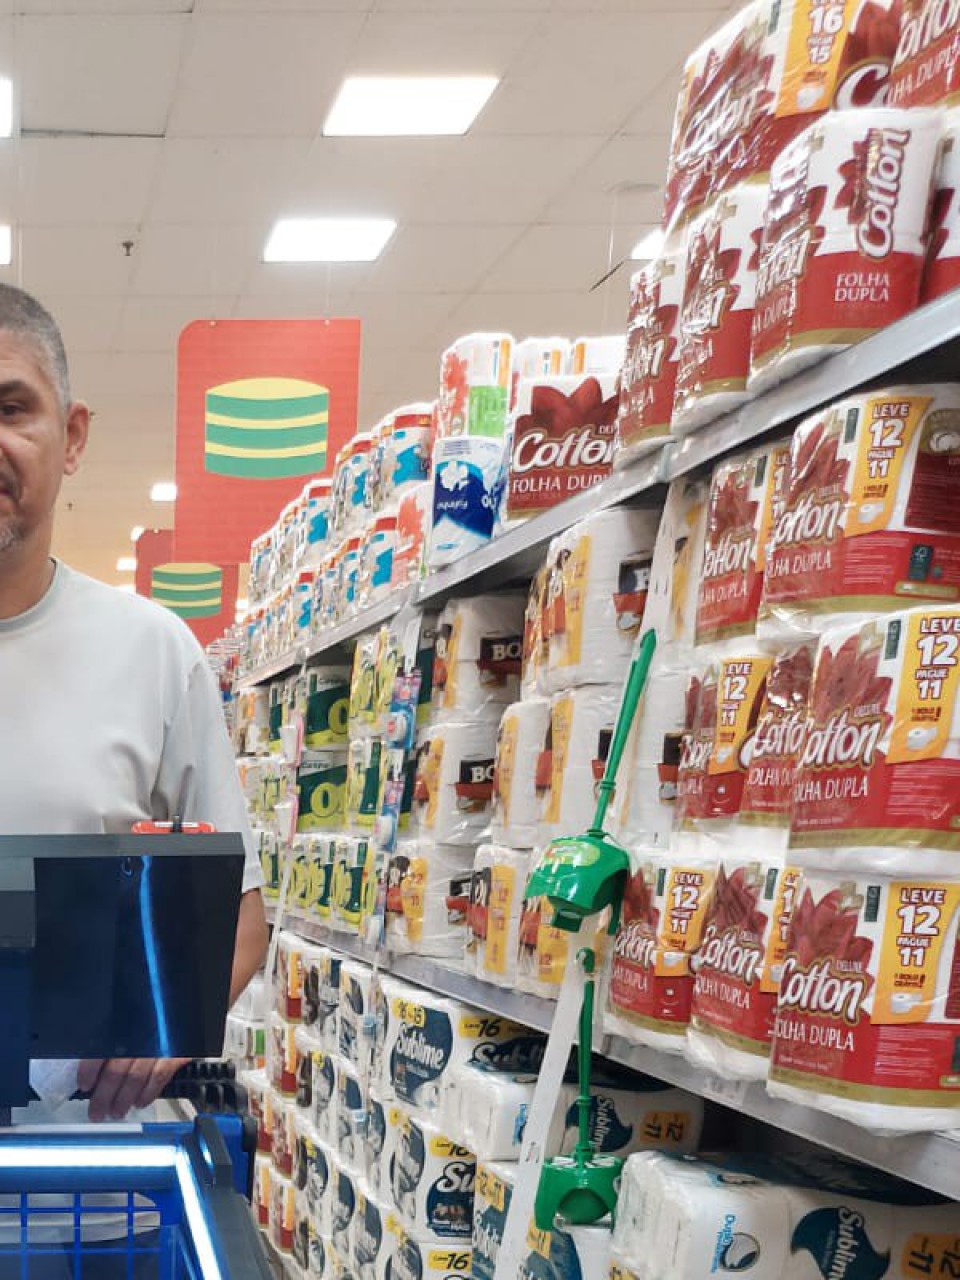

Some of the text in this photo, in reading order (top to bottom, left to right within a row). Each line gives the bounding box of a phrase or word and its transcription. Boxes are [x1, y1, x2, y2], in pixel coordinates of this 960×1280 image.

[808, 7, 843, 33] 16
[809, 45, 832, 64] 15
[857, 128, 911, 261] Cotton
[836, 272, 890, 287] FOLHA
[834, 287, 890, 302] DUPLA
[872, 403, 909, 418] LEVE
[869, 418, 905, 448] 12
[869, 459, 889, 479] 11
[512, 474, 561, 494] FOLHA
[917, 634, 959, 667] 12
[722, 676, 748, 701] 12
[917, 679, 941, 700] 11
[721, 710, 739, 726] 11
[825, 775, 869, 799] DUPLA
[673, 873, 703, 886] LEVE
[671, 886, 699, 911] 12
[900, 887, 946, 903] LEVE
[670, 918, 688, 935] 11
[897, 904, 940, 937] 12
[899, 947, 926, 968] 11
[778, 957, 864, 1025] Cotton
[809, 1020, 855, 1052] DUPLA
[596, 1094, 613, 1152] Sublim
[446, 1252, 470, 1270] 16
